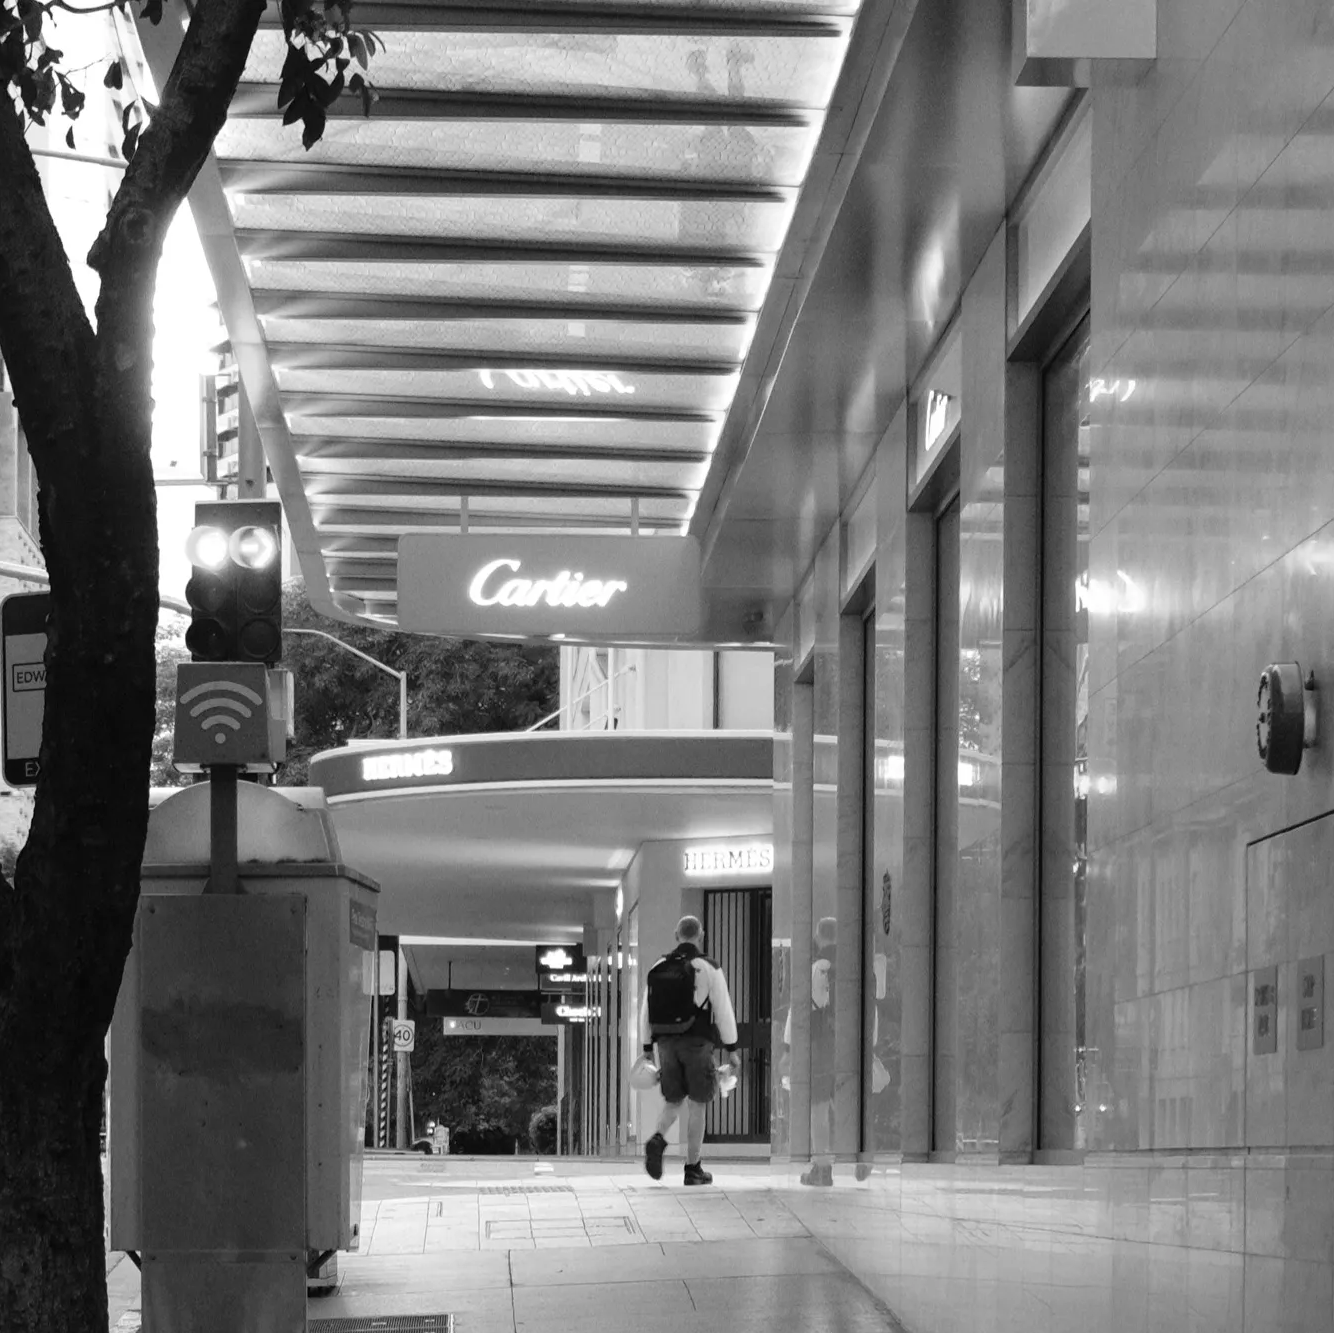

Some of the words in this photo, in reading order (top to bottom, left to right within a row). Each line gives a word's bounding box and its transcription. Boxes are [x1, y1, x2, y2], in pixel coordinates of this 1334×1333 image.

[469, 557, 628, 607] Cartier
[16, 671, 47, 684] EDW
[684, 846, 771, 872] HERMÈS
[394, 1029, 411, 1042] 40
